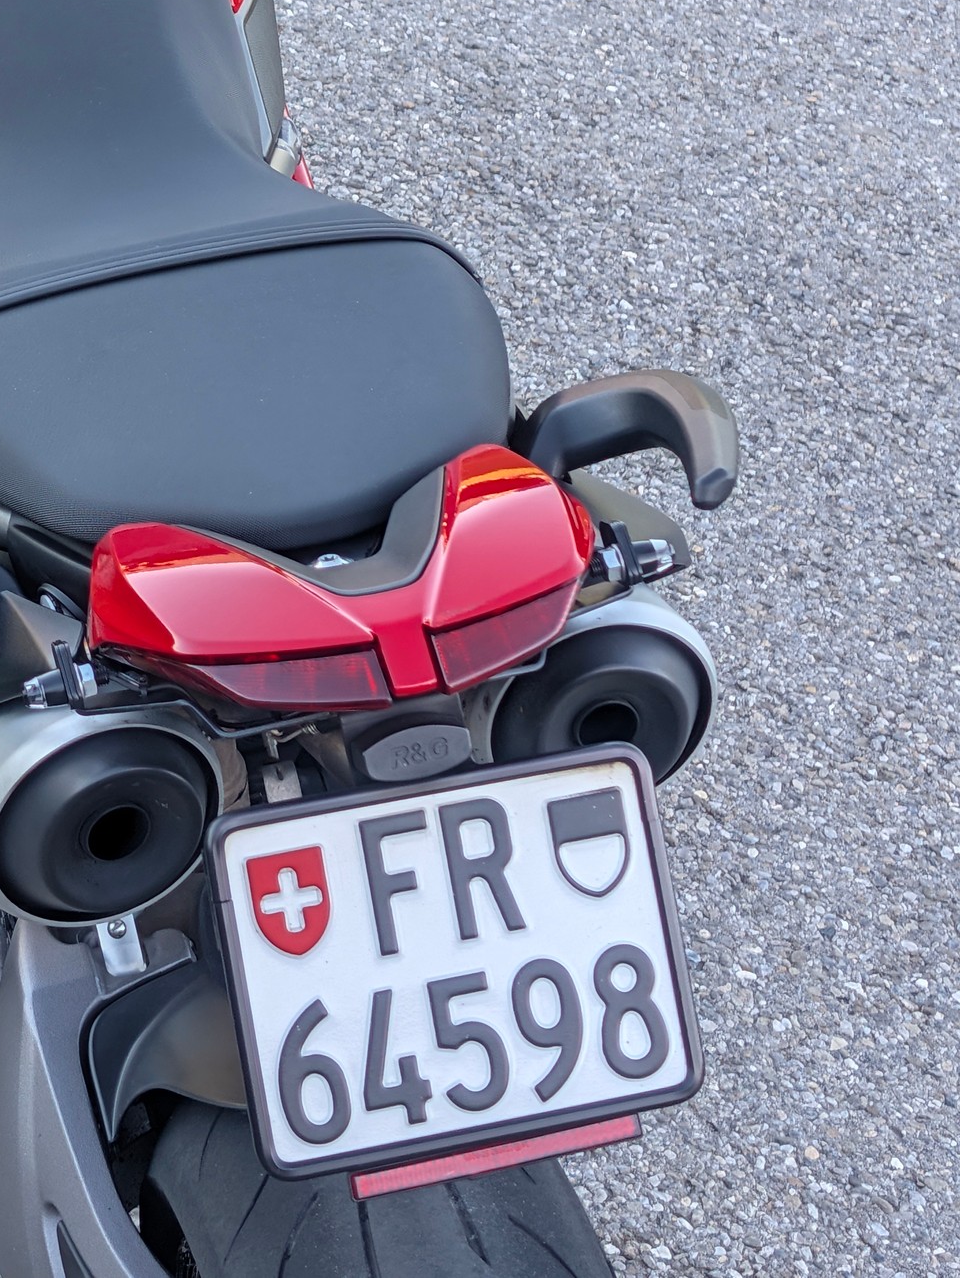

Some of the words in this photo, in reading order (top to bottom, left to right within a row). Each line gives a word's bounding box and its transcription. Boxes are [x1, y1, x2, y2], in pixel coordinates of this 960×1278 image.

[390, 736, 449, 770] R&G
[358, 798, 527, 956] FR
[278, 943, 670, 1145] 64598
